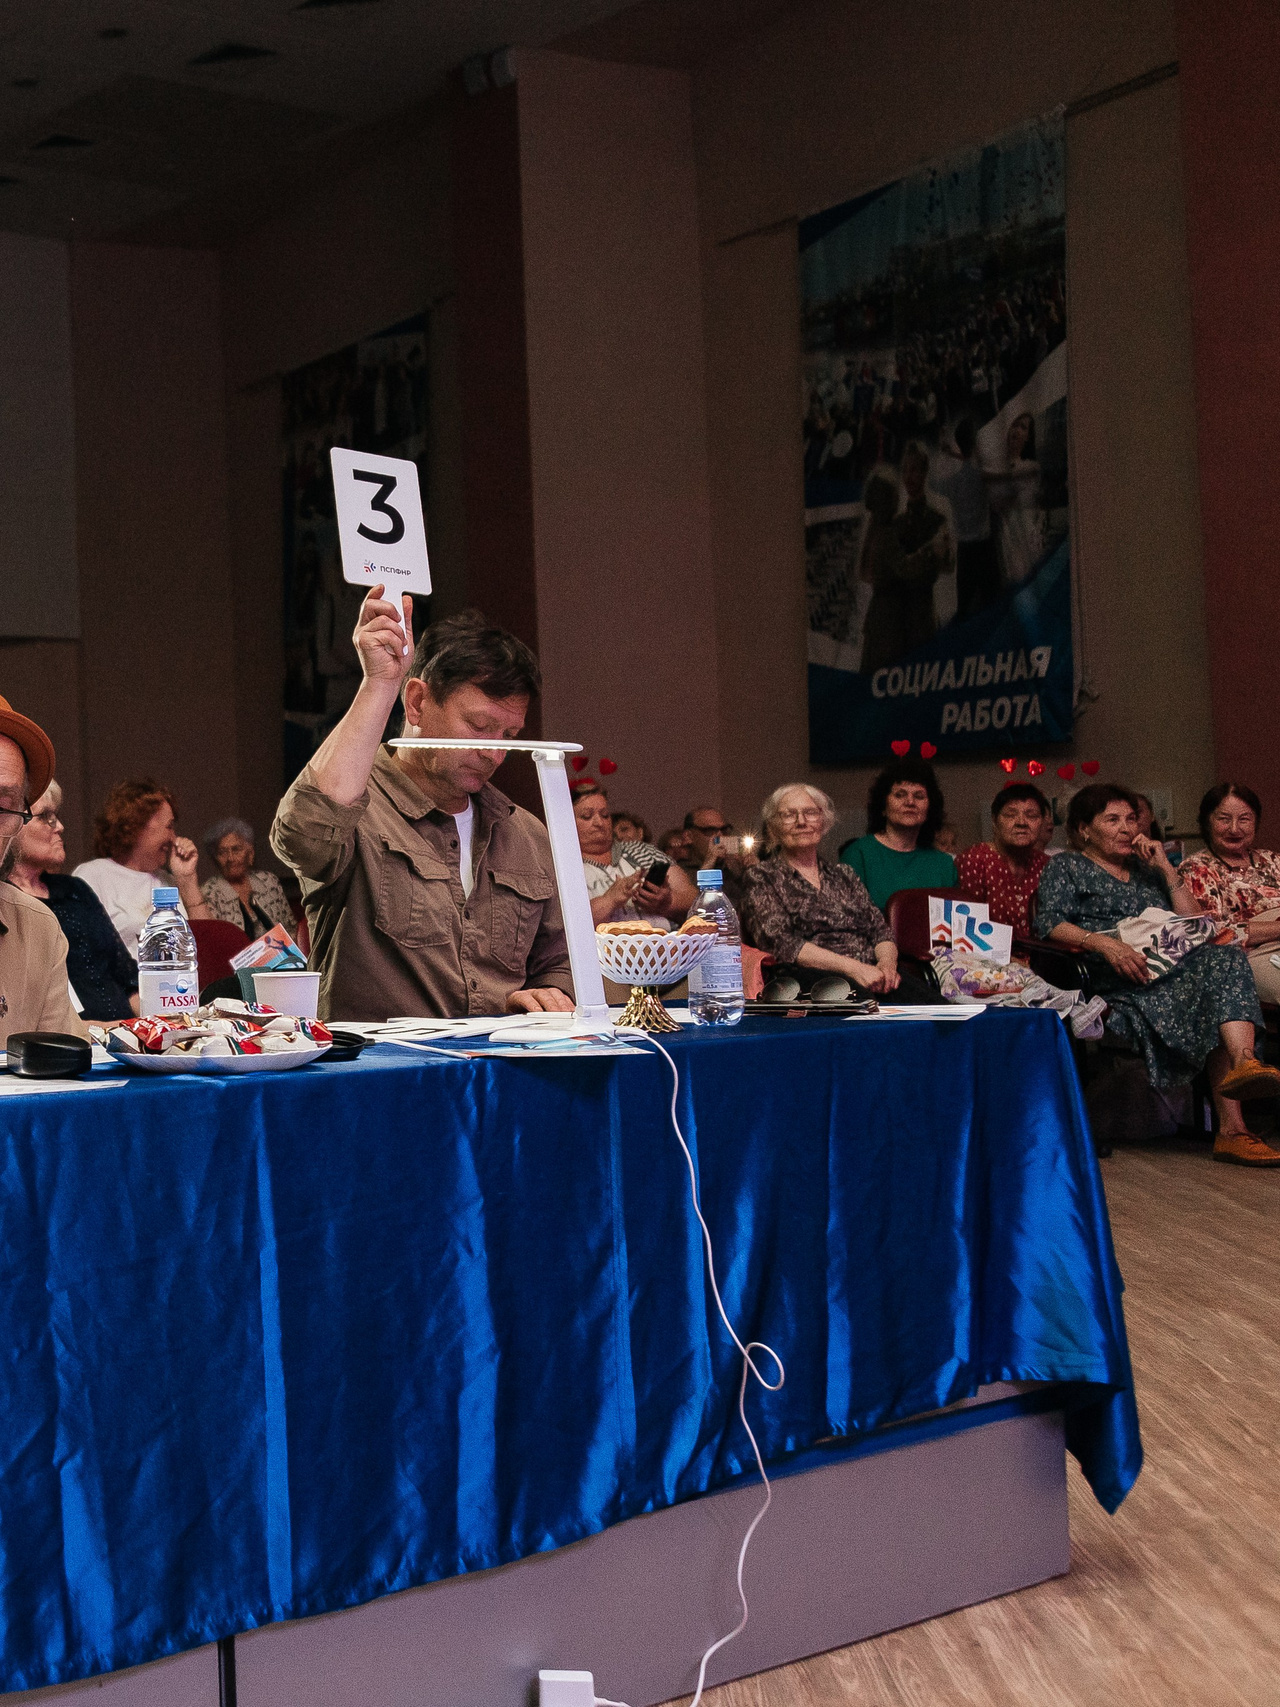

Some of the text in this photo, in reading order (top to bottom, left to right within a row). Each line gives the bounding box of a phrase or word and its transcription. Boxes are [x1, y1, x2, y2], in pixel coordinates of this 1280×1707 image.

[352, 468, 406, 545] 3
[380, 565, 411, 576] ПСПФНР
[871, 645, 1053, 699] СОЦИАЛЬНАЯ
[940, 694, 1042, 734] РАБОТА
